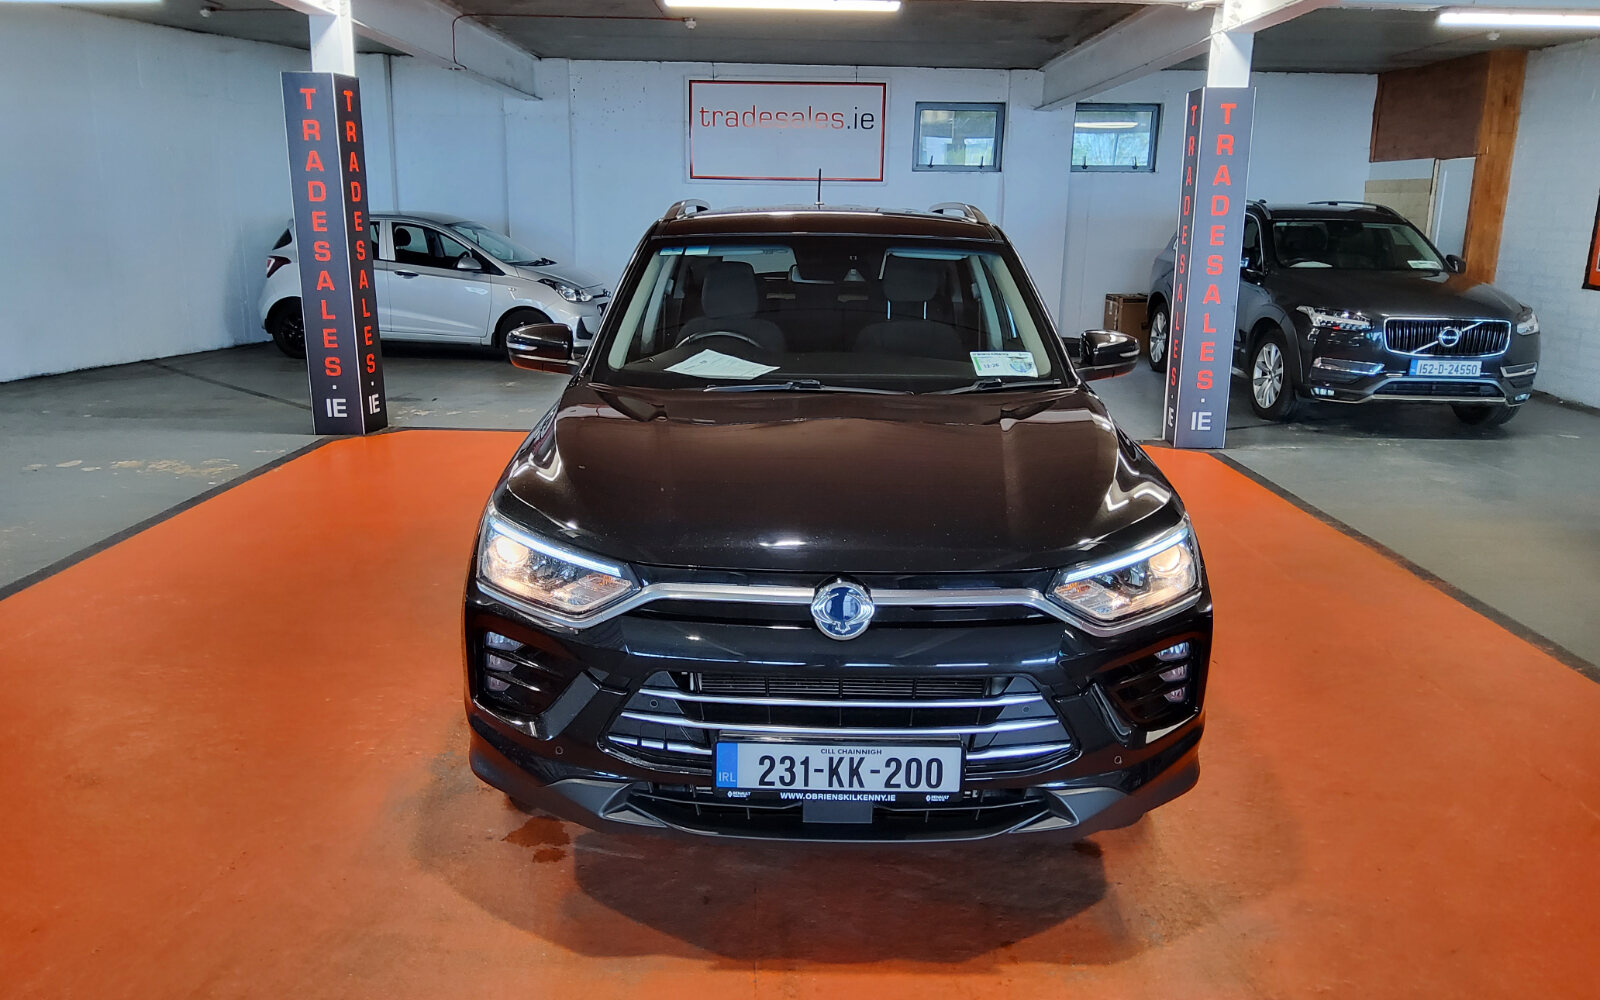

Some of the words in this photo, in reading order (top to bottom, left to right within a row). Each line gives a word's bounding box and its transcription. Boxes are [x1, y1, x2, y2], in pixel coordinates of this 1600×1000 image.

[699, 105, 875, 130] tradesales.ie
[1418, 363, 1478, 375] 152-D-24550
[718, 772, 737, 783] IRL
[758, 755, 943, 789] 231-KK-200
[780, 792, 896, 802] WWW.OBRIENSKILKENNY.IE
